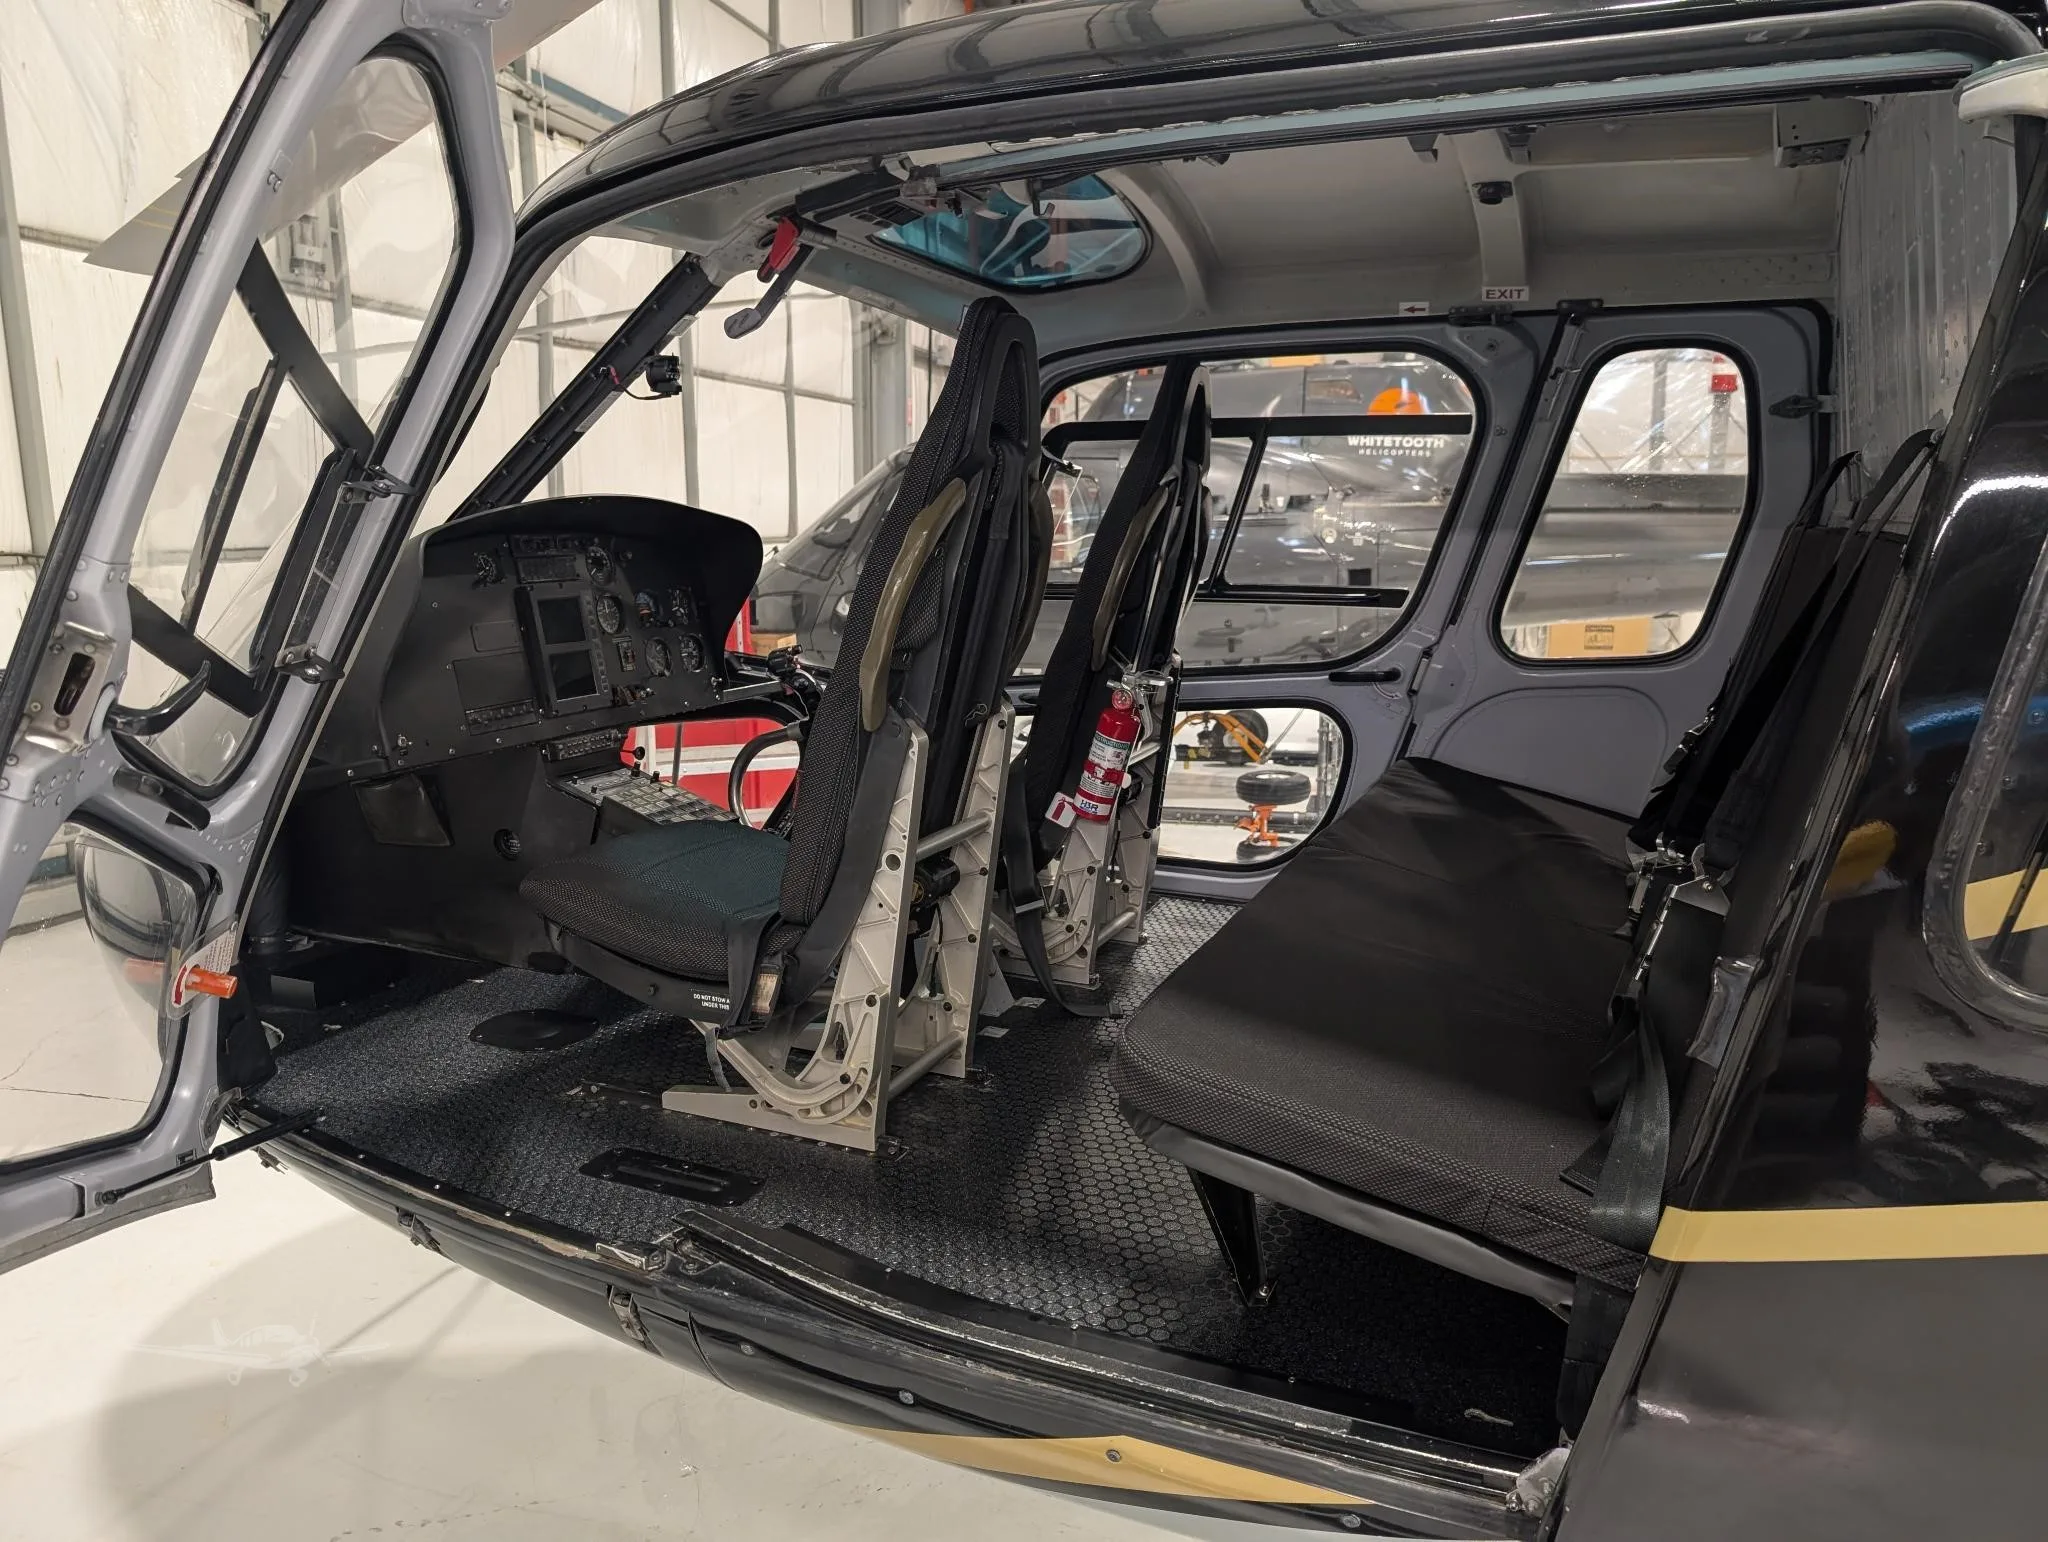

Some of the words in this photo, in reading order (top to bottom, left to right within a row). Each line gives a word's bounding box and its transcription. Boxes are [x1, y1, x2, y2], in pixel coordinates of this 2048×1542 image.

[1485, 288, 1525, 299] EXIT
[1347, 436, 1445, 448] WHITETOOTH
[1358, 448, 1431, 457] HELICOPTERS
